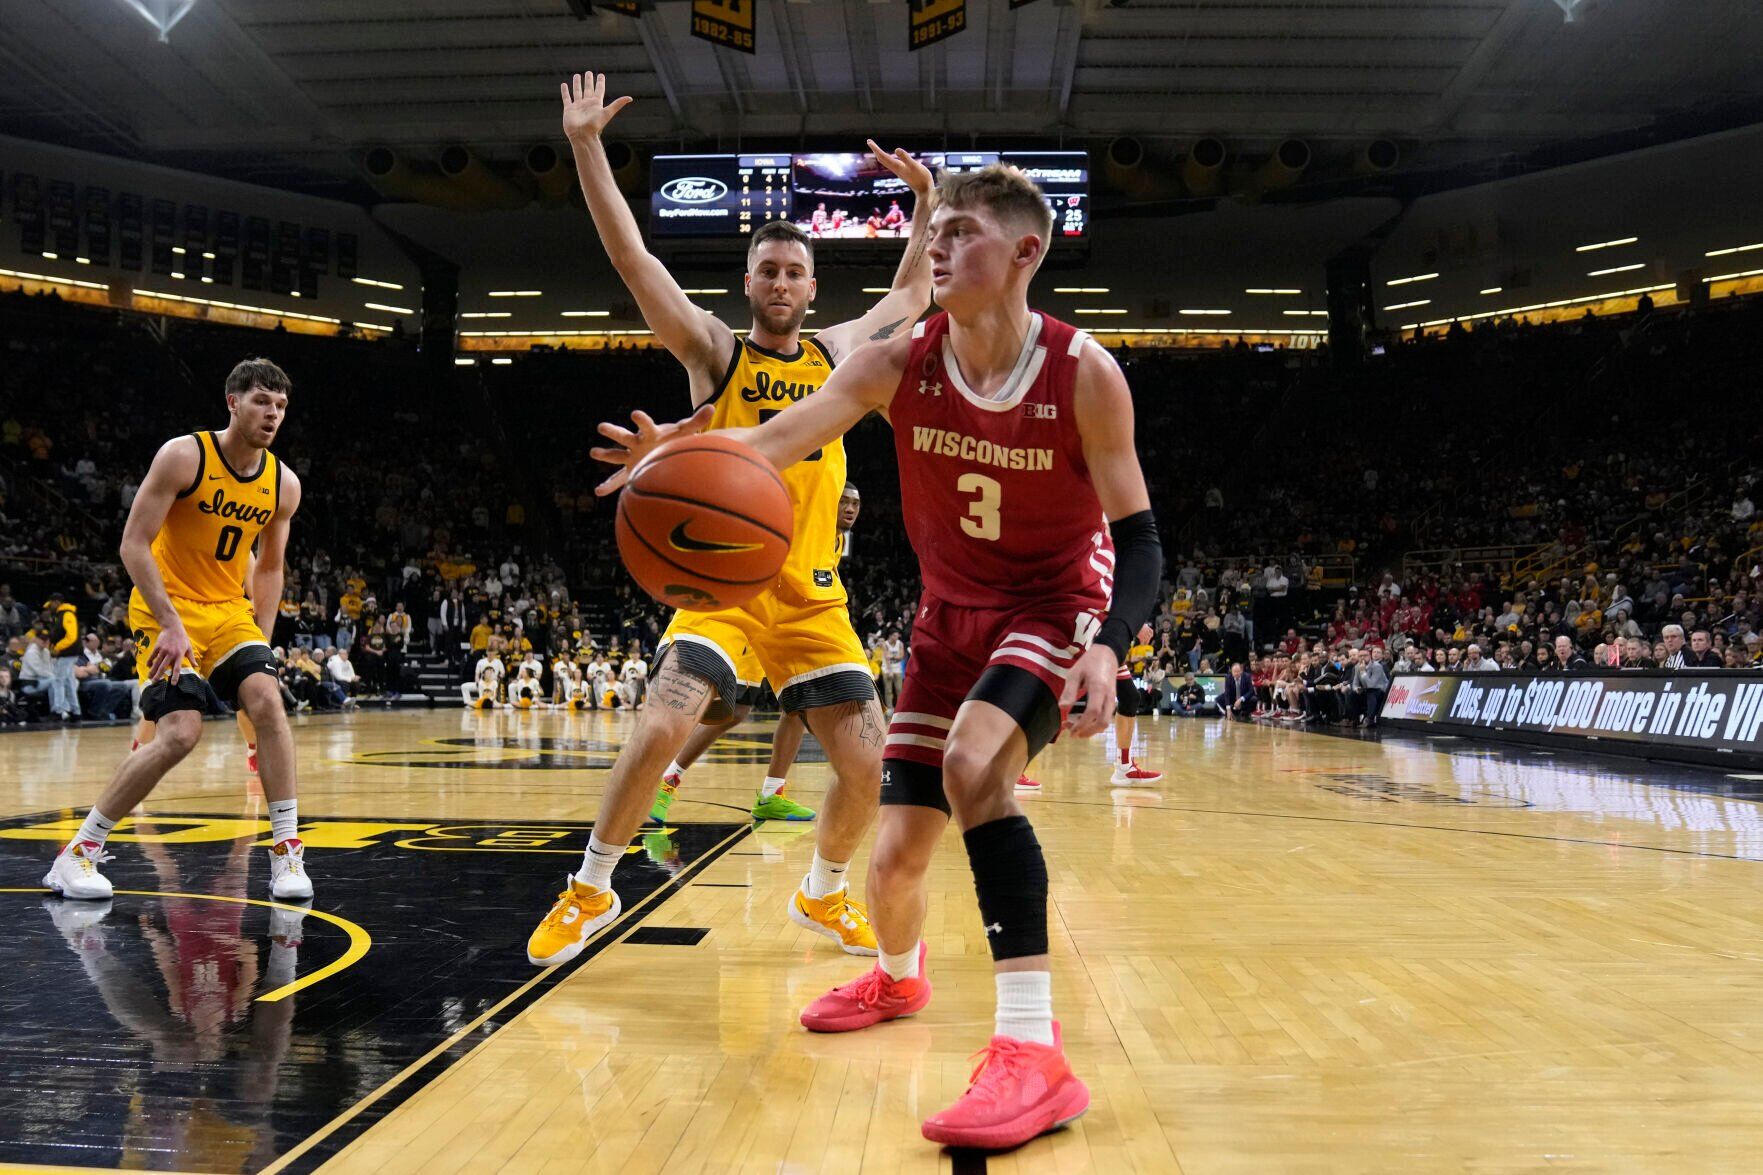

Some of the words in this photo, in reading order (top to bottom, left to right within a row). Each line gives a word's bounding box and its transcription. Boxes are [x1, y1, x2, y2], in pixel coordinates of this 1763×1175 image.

[672, 180, 716, 199] Ford
[741, 198, 751, 207] 11
[739, 211, 751, 220] 22
[1065, 209, 1083, 222] 25
[913, 426, 1054, 471] WISCONSIN
[198, 488, 272, 525] Iowa
[957, 472, 1002, 541] 3
[215, 525, 244, 562] 0
[1450, 679, 1484, 725] Plus,
[1481, 687, 1506, 727] up
[1499, 683, 1523, 723] to
[1517, 677, 1604, 733] $100,000
[1593, 690, 1656, 734] more
[1648, 681, 1682, 735] in
[1674, 681, 1727, 739] the
